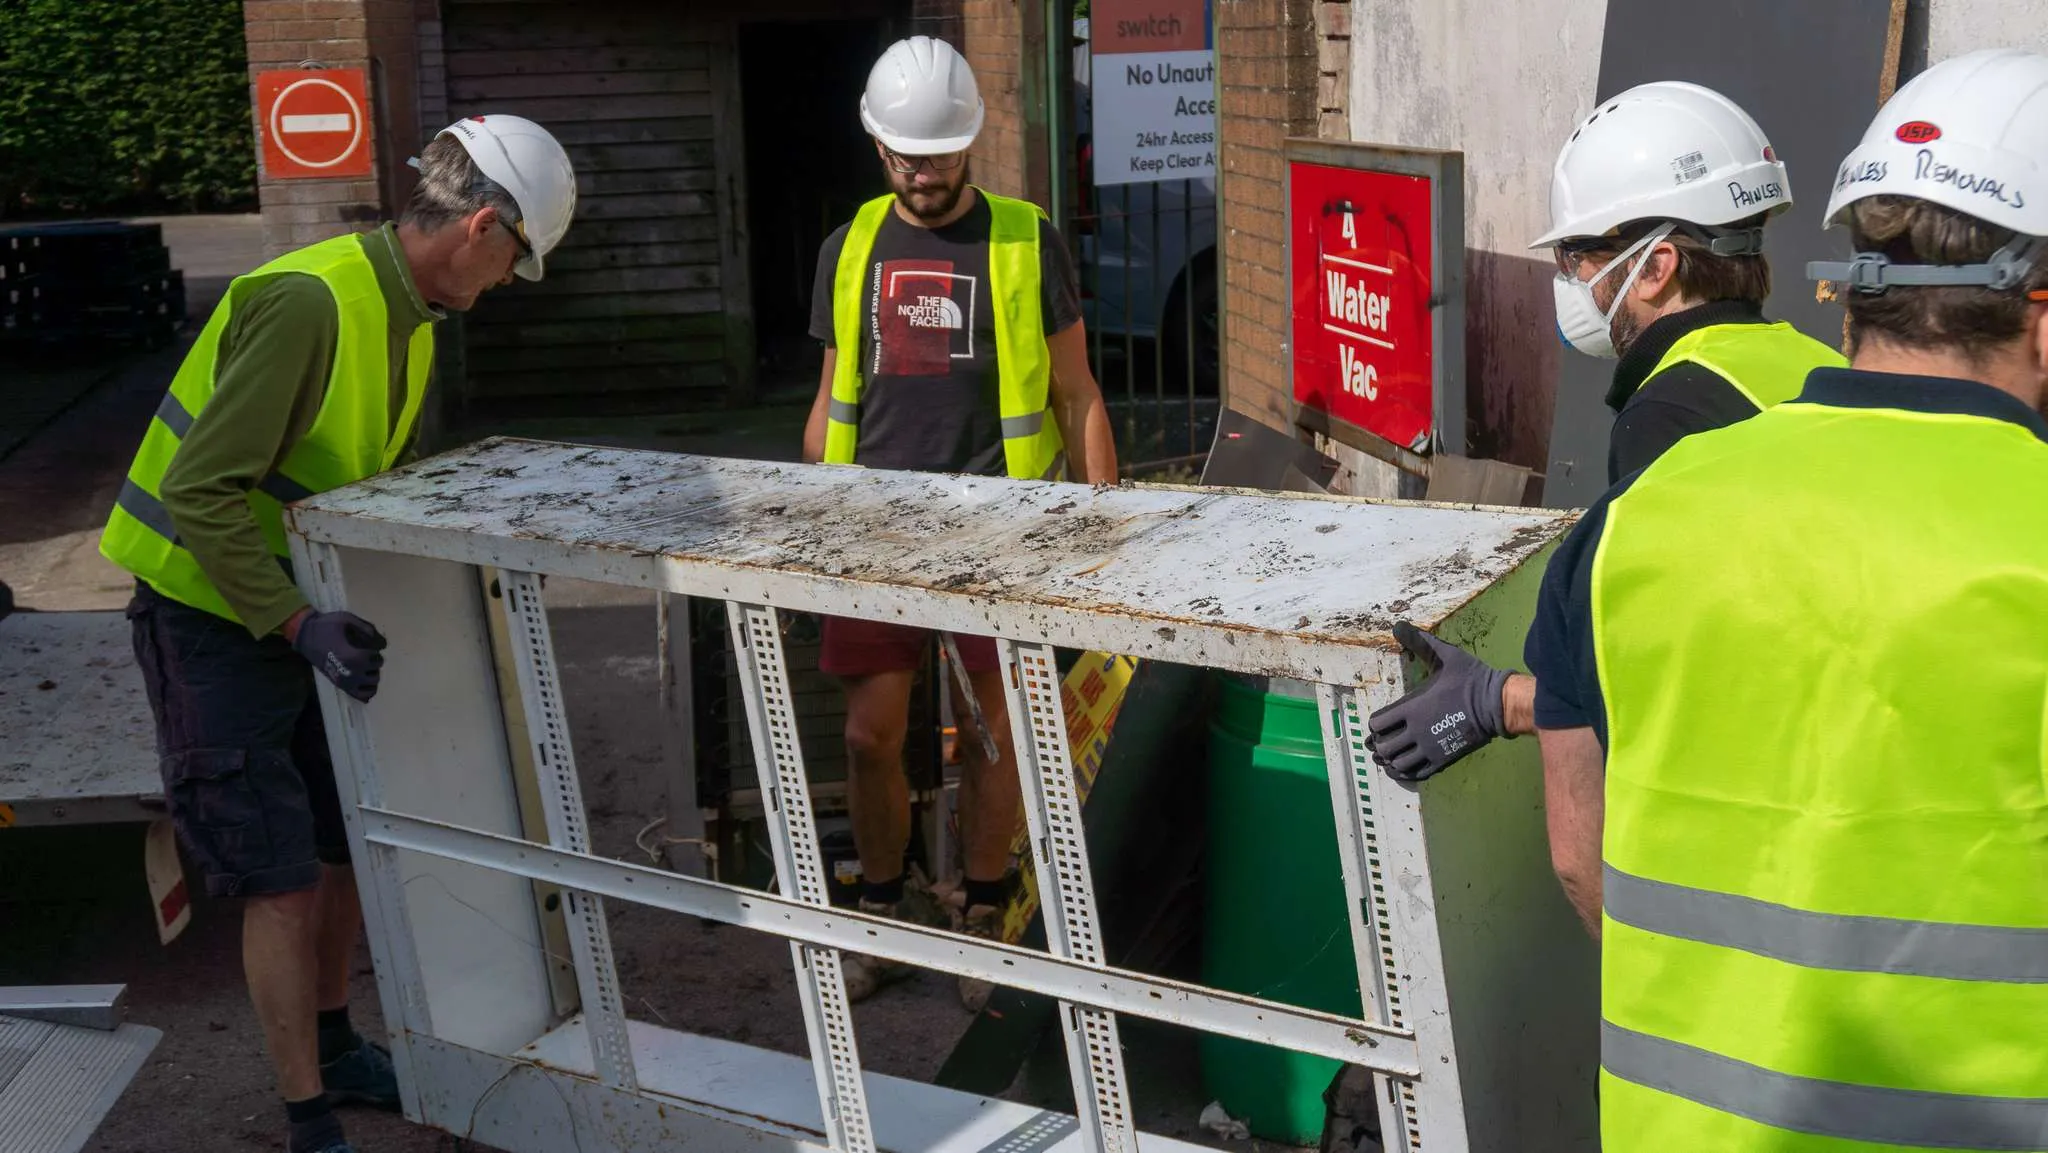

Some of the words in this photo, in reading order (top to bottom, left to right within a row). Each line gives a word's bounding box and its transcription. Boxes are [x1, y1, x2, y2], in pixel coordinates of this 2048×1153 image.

[1117, 13, 1181, 38] switch
[1126, 64, 1153, 85] No
[1136, 133, 1167, 148] 24hr
[1170, 131, 1213, 146] Access
[1900, 125, 1935, 139] JSP
[1130, 157, 1164, 174] Keep
[1167, 153, 1201, 169] Clear
[1727, 181, 1784, 208] PAINLESS
[871, 261, 883, 313] EXPLORING
[898, 305, 940, 316] NORTH
[917, 295, 940, 307] THE
[1327, 270, 1391, 332] Water
[871, 314, 881, 341] STOP
[909, 316, 940, 327] FACE
[1339, 343, 1378, 401] Vac
